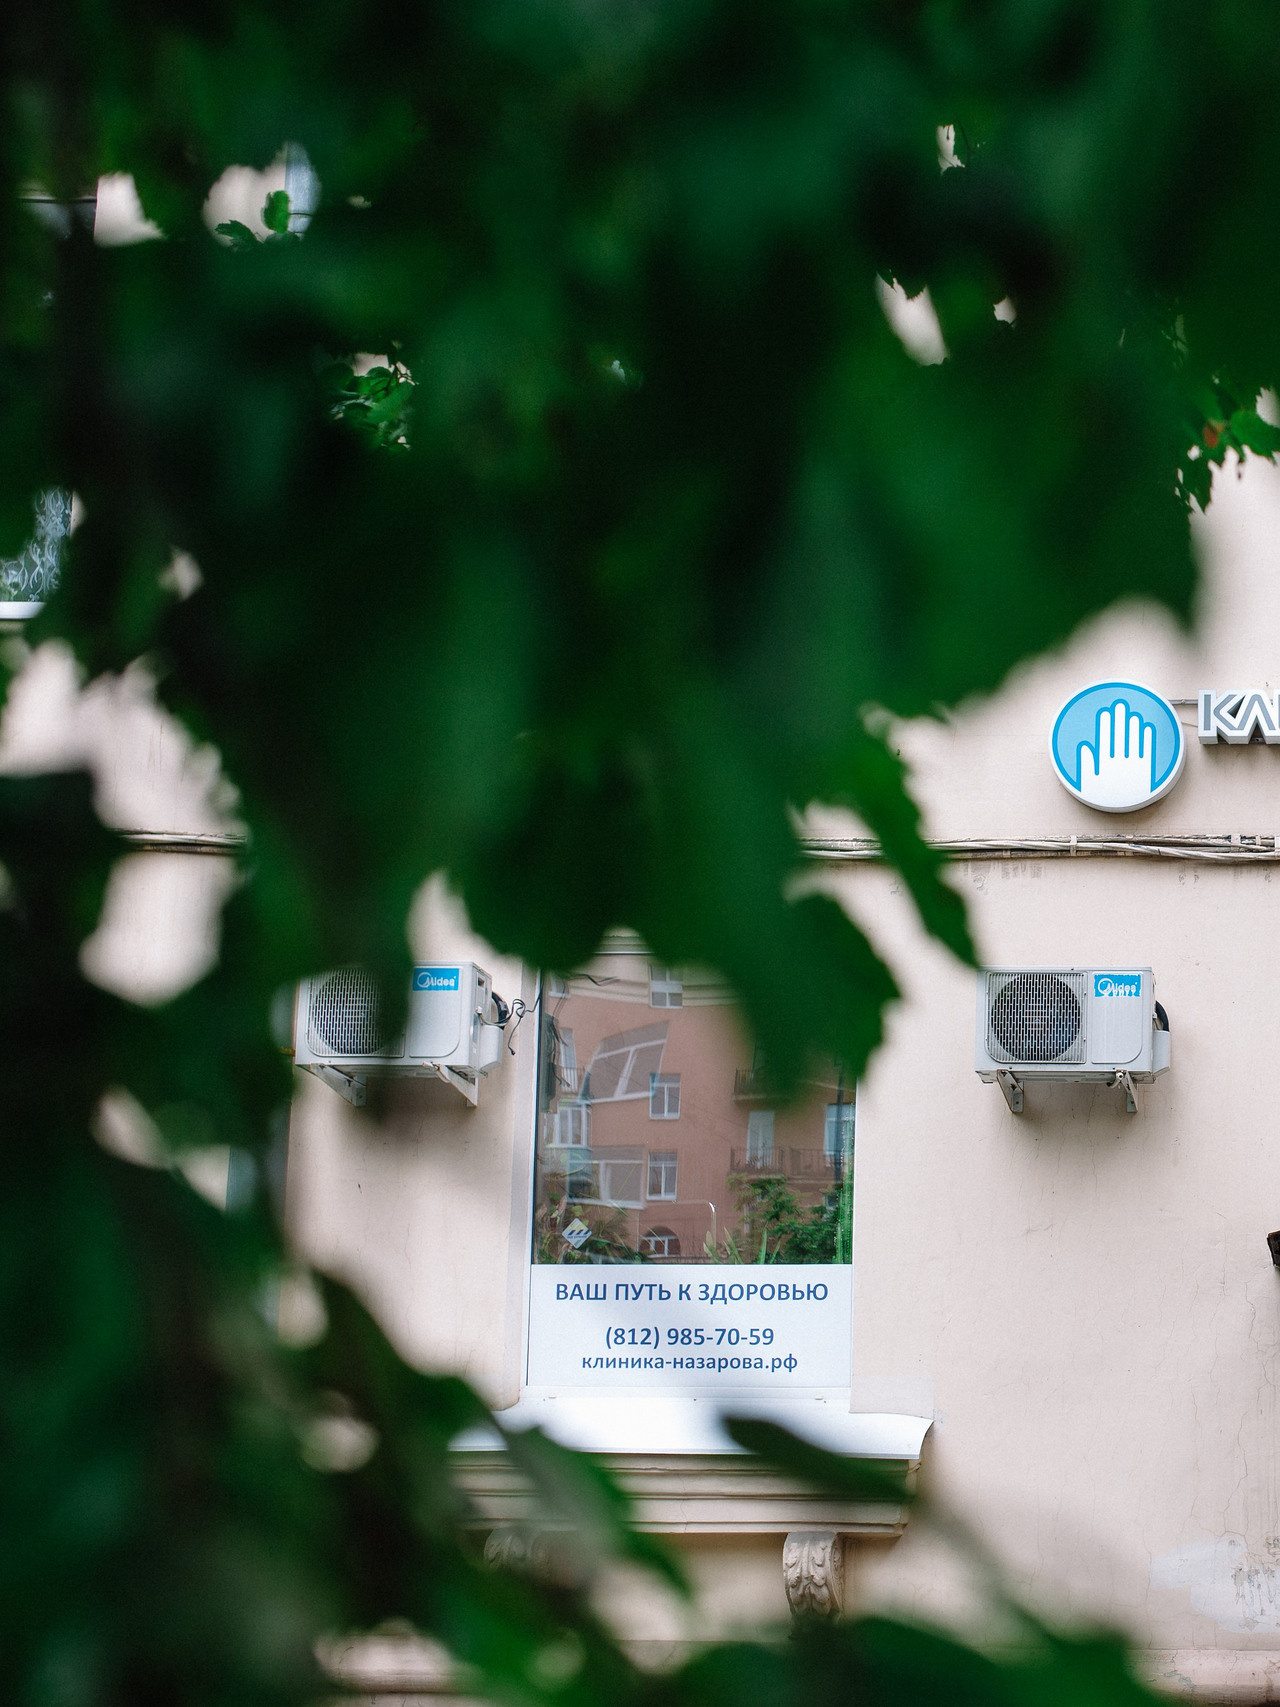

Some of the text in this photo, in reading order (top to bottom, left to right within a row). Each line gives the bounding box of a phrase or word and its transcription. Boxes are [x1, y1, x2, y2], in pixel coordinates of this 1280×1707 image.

[417, 971, 456, 988] Midea
[1098, 978, 1138, 995] Midea
[555, 1282, 829, 1305] ВАШ ПУТЬ К ЗДОРОВЬЮ
[605, 1326, 775, 1349] (812) 985-70-59
[581, 1353, 798, 1373] клиника-назарова.рф
